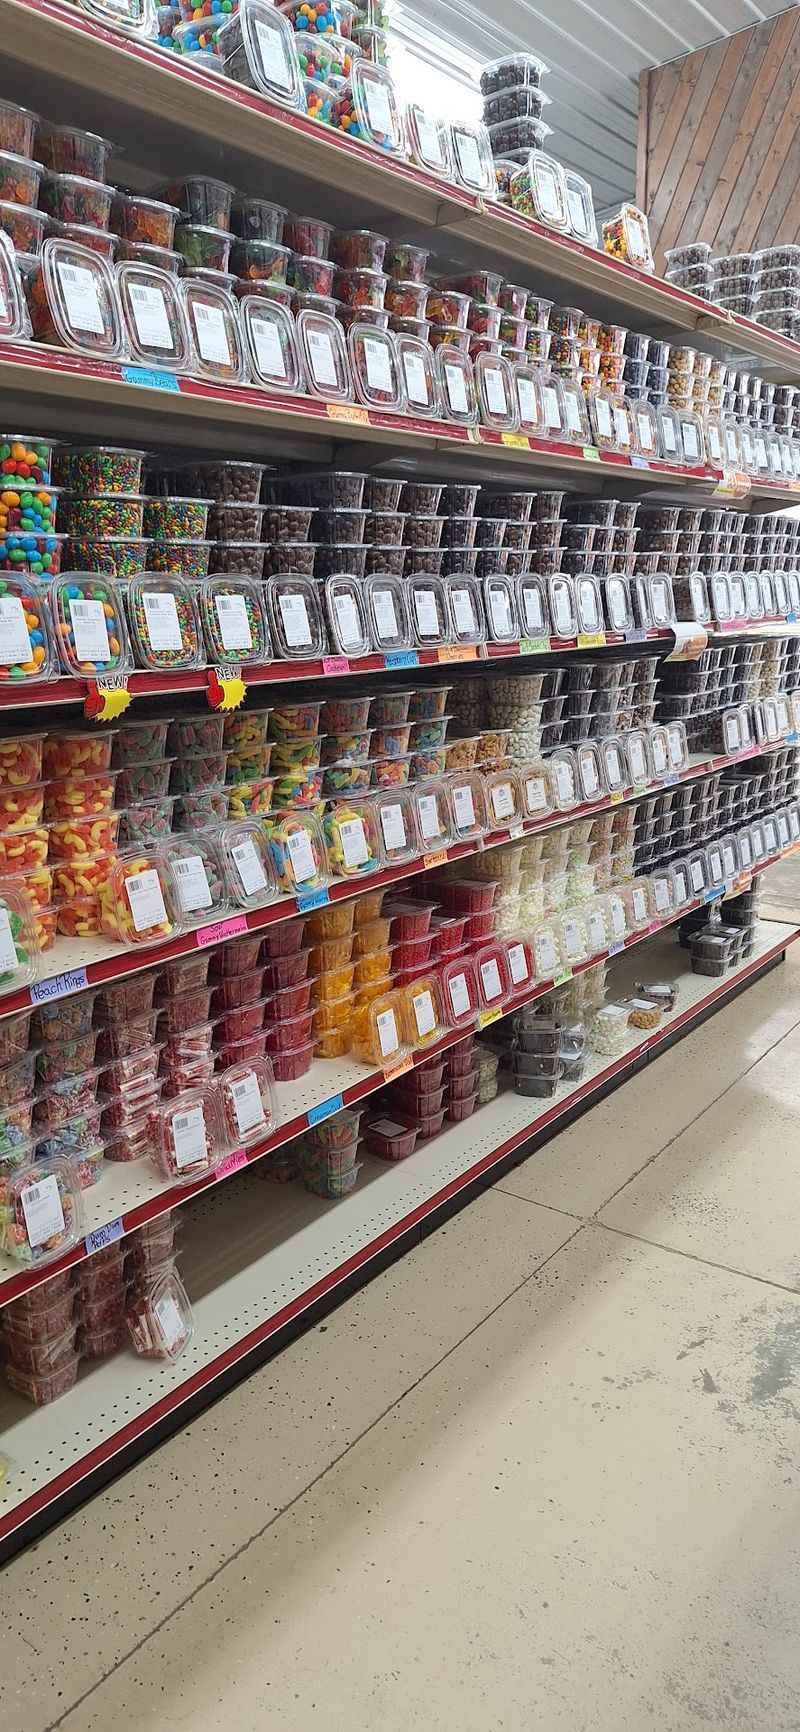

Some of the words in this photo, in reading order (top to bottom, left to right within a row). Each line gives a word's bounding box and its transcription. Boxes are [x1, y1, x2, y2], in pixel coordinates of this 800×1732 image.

[98, 675, 128, 691] NEW!
[33, 977, 62, 1000] Peach
[64, 972, 86, 994] Rings
